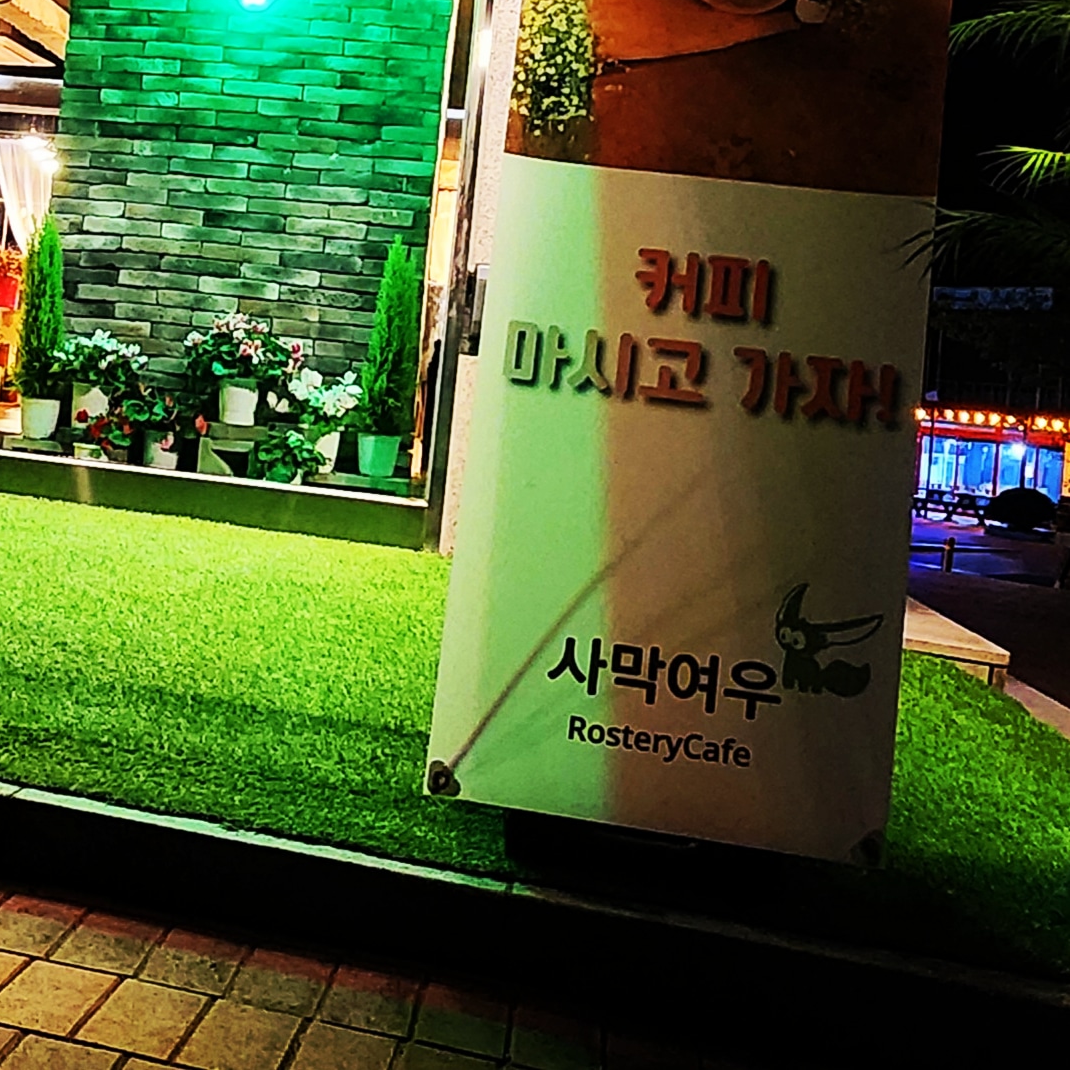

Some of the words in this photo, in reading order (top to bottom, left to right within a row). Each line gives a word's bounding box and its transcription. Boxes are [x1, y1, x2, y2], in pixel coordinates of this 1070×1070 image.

[635, 247, 772, 322] 커피
[502, 319, 707, 405] 마시고
[732, 345, 897, 424] 가자!
[546, 636, 782, 721] 사막여우
[566, 714, 753, 769] RosteryCafe
